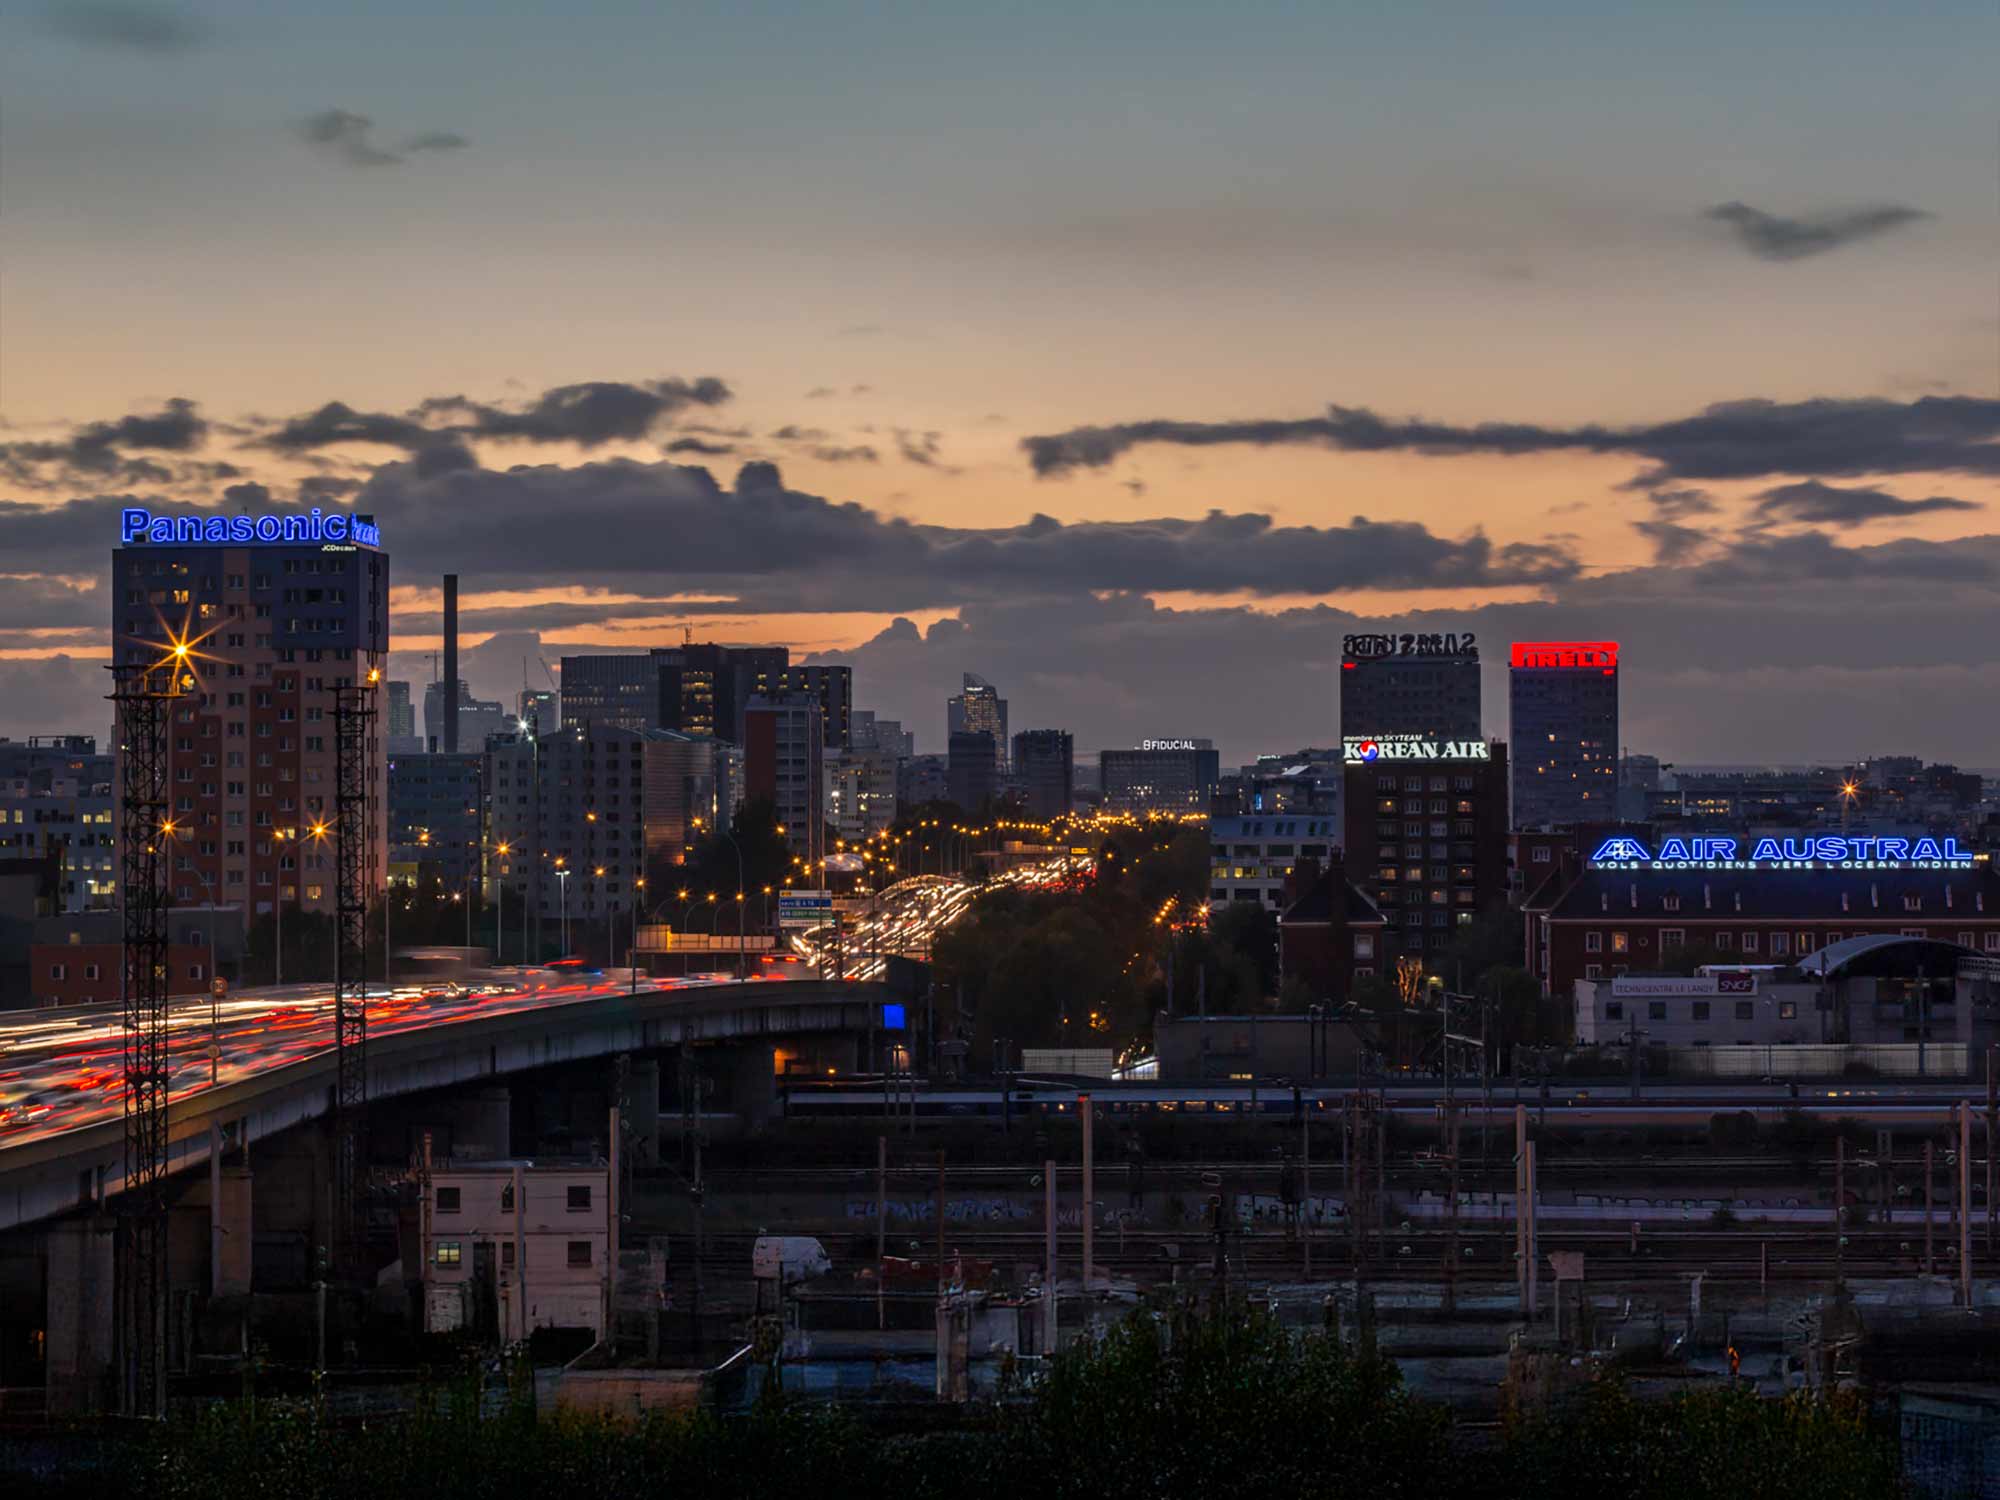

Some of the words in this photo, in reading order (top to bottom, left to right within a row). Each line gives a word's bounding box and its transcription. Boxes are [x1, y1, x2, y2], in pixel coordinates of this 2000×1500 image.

[121, 508, 347, 542] Panasonic
[1151, 740, 1196, 750] FIDUCIAL
[1343, 741, 1439, 760] KOREAN
[1440, 741, 1489, 759] AIR
[1658, 838, 1737, 860] AIR
[1752, 837, 1973, 860] AUSTRAL
[1596, 861, 1640, 870] VOLS
[1652, 861, 1757, 870] QUOTIDIENS
[1770, 861, 1814, 870] VERS
[1912, 861, 1972, 870] INDIEN
[1719, 979, 1752, 993] SNCF
